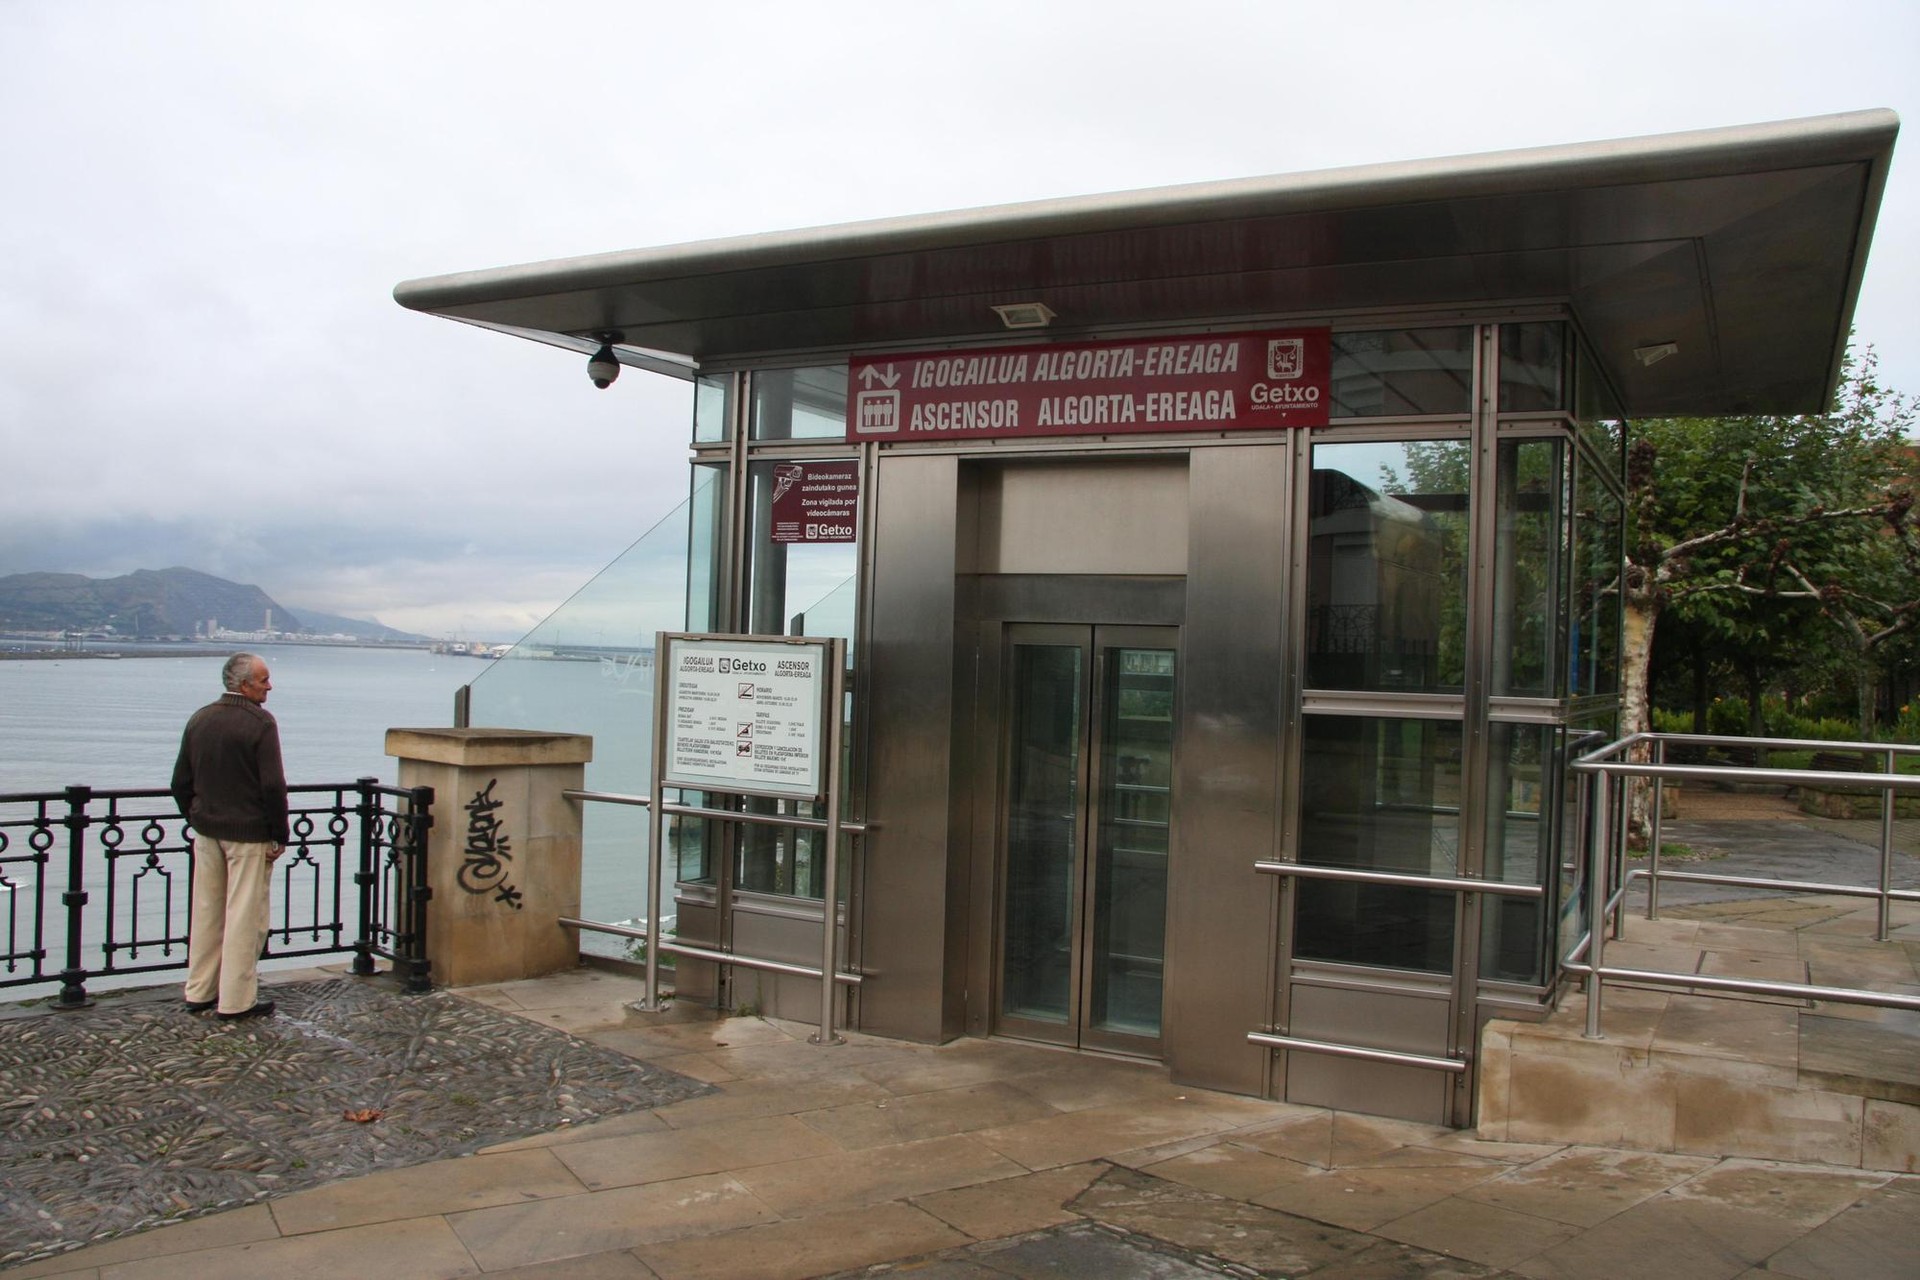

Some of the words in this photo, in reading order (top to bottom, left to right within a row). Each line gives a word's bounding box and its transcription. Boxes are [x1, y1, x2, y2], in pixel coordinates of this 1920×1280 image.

[911, 355, 1028, 389] IGOGAILUA
[1034, 342, 1239, 383] ALGORTA-EREAGA
[1250, 382, 1320, 403] Getxo
[910, 399, 1019, 431] ASCENSOR
[1037, 390, 1237, 427] ALGORTA-EREAGA
[1275, 402, 1319, 410] AYUNTAMIENTO
[807, 473, 852, 481] Bideokameraz
[802, 484, 835, 492] zaindutako
[837, 484, 857, 492] gunea
[819, 498, 843, 507] vigilada
[844, 498, 856, 507] por
[806, 509, 850, 517] videocámaras
[818, 523, 853, 536] Getxo
[682, 656, 713, 666] IGOGAILUA
[732, 658, 767, 672] Getxo
[777, 660, 810, 671] ASCENSOR
[679, 665, 715, 673] ALGORTA-EREAGA
[774, 670, 812, 679] ALGORTA-EREAGA
